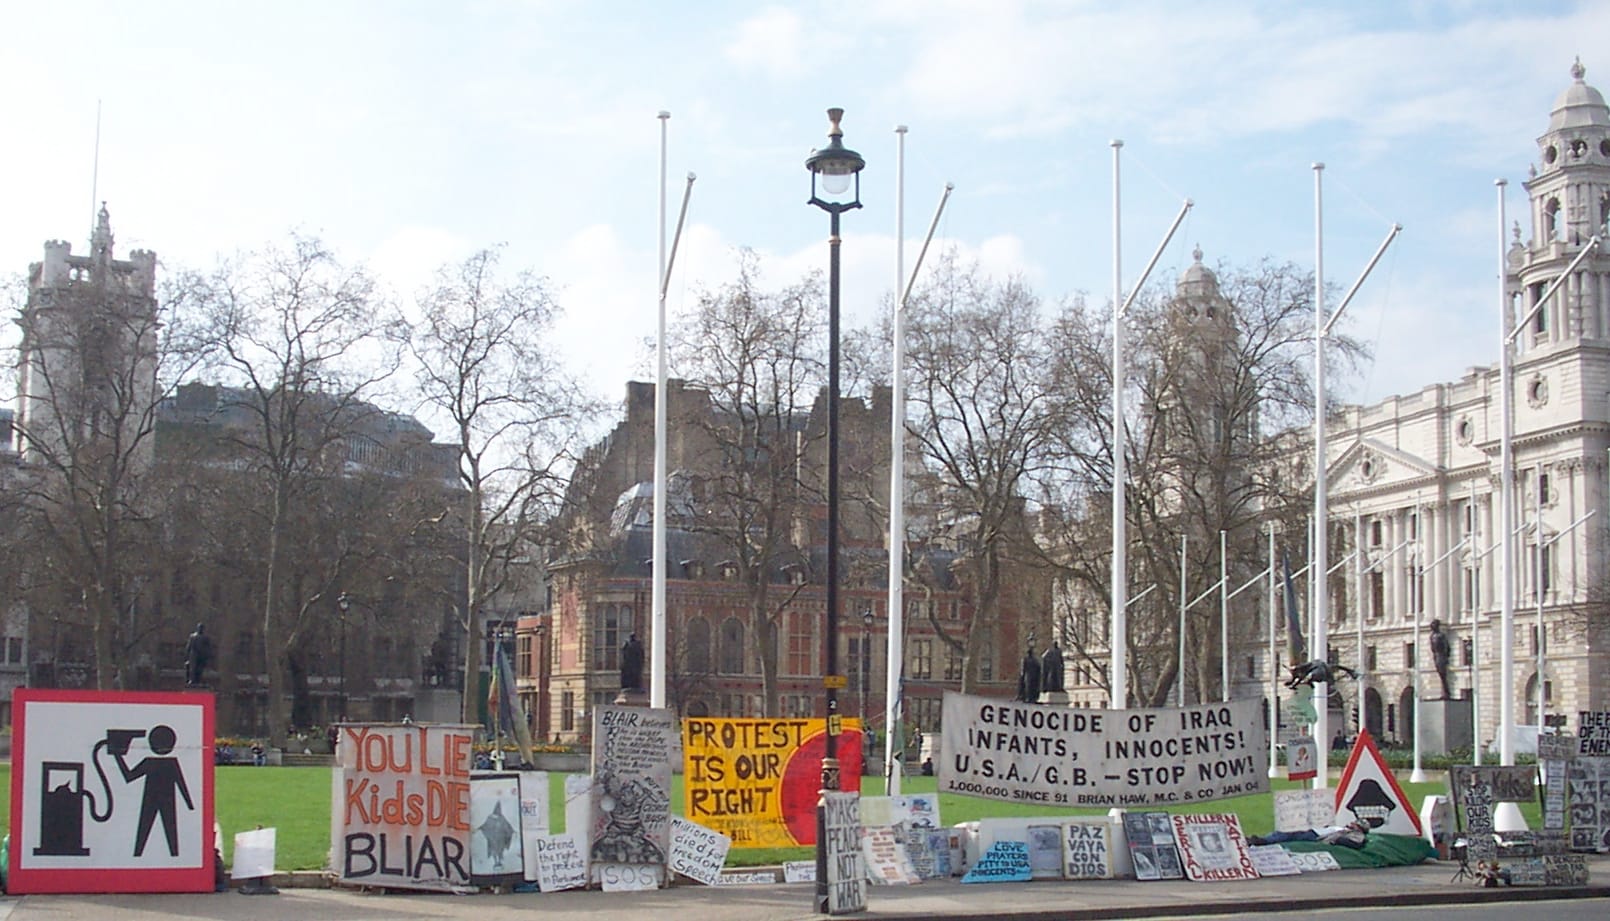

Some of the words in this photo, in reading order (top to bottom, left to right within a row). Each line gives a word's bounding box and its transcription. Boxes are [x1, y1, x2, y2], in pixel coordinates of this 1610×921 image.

[602, 711, 638, 727] BLAIR
[980, 704, 1103, 733] GENOCIDE
[1128, 714, 1156, 733] OF
[1180, 707, 1232, 730] IRAQ
[1579, 711, 1603, 726] THE
[688, 720, 808, 749] PROTEST
[968, 728, 1078, 761] INFANTS,
[1105, 731, 1245, 759] INNOCENTS!
[1580, 726, 1595, 738] OF
[420, 728, 471, 777] LIE
[690, 755, 724, 782] IS
[735, 753, 780, 780] OUR
[1198, 755, 1254, 782] NOW!
[344, 778, 424, 826] Kids
[427, 780, 470, 831] DIE
[691, 787, 773, 817] RIGHT
[949, 780, 1008, 797] 1,000,000
[1013, 789, 1049, 801] SINCE
[1055, 792, 1068, 802] 91
[1078, 794, 1115, 804] BRIAN
[1154, 792, 1178, 802] M.C.
[1184, 791, 1193, 800] &
[1198, 789, 1214, 798] CO
[1222, 784, 1242, 795] JAN
[827, 797, 860, 825] MAKE
[1184, 814, 1225, 824] KILLER
[1467, 806, 1488, 818] OUR
[670, 819, 716, 845] Millions
[827, 826, 863, 854] PEACE
[1070, 825, 1103, 839] PAZ
[344, 832, 469, 880] BLIAR
[675, 835, 707, 852] died
[707, 848, 724, 860] for
[994, 844, 1024, 852] LOVE
[1067, 840, 1106, 852] VAYA
[1073, 852, 1100, 863] CON
[604, 865, 654, 885] SOS
[837, 854, 858, 880] NOT
[1068, 863, 1106, 876] DIOS
[1203, 867, 1243, 880] KILLER
[836, 882, 861, 908] WAR
